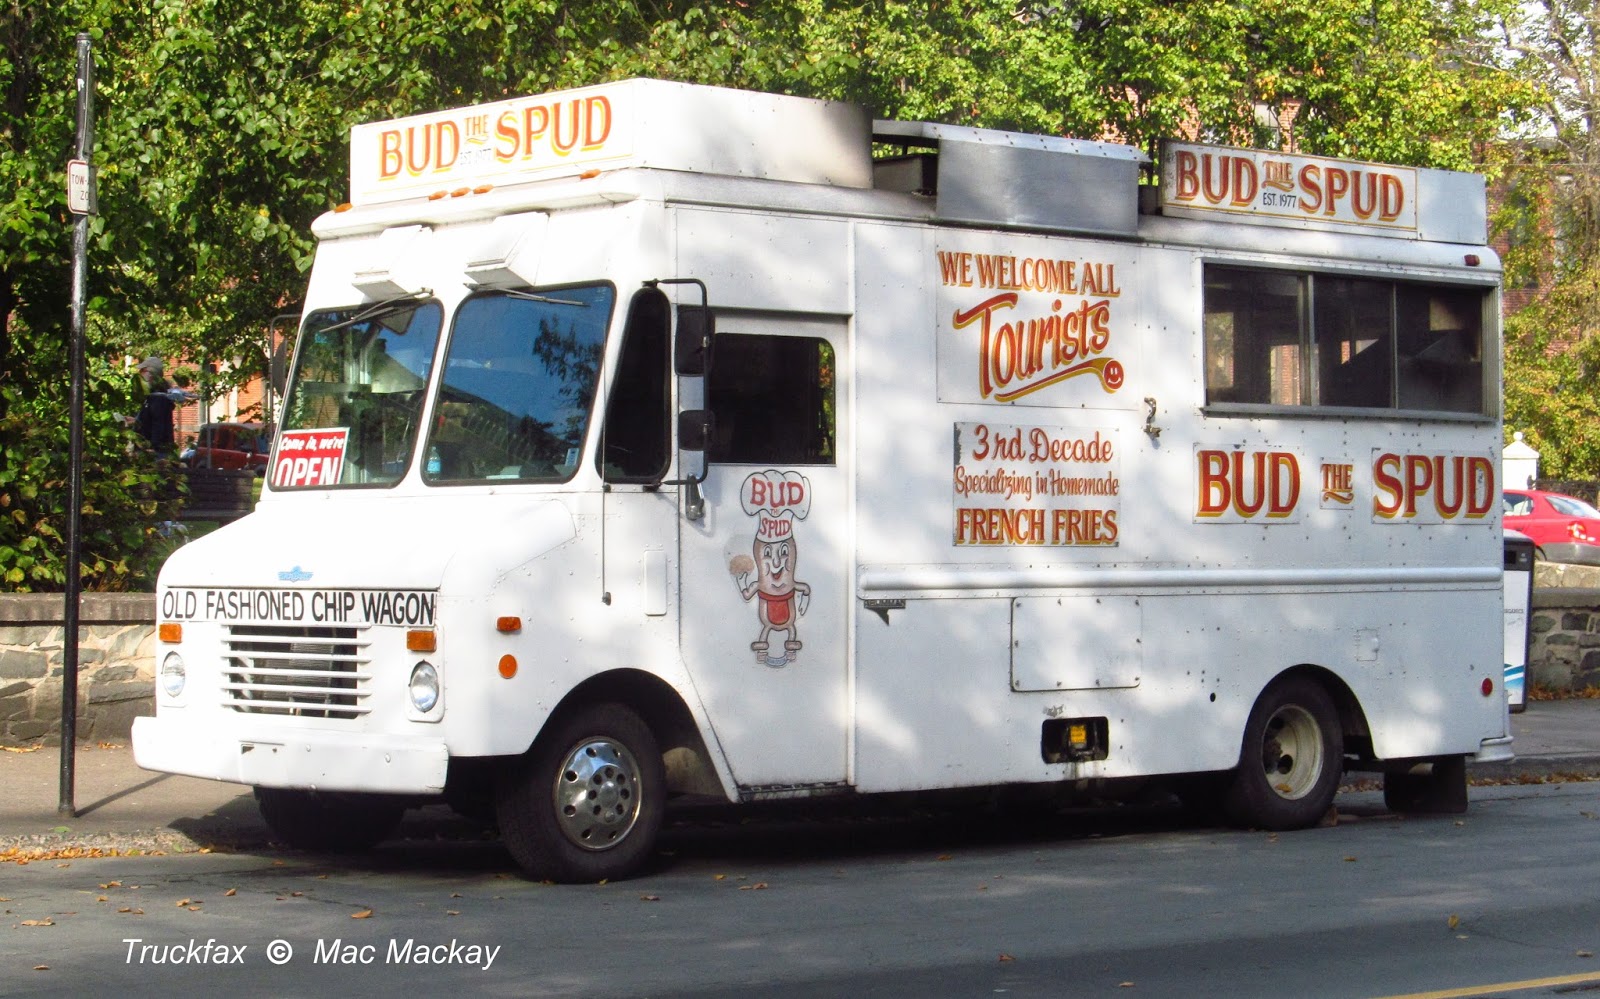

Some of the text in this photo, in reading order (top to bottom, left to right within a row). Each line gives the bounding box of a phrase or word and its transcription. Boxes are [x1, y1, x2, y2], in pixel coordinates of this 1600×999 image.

[378, 95, 612, 181] BUD THE SPUD
[1175, 150, 1405, 222] BUD THE SPUD
[1262, 192, 1297, 209] EST. 1977
[938, 251, 1121, 297] WE WELCOME ALL
[953, 292, 1111, 400] Tourists
[280, 436, 305, 451] Come
[319, 435, 345, 450] we're
[973, 424, 1114, 464] 3rd Decade
[274, 457, 340, 487] OPEN
[954, 465, 1119, 501] Specializing in Homemade
[1195, 450, 1495, 519] BUD THE SPUD
[751, 477, 804, 508] BUD
[760, 517, 791, 538] SPUD
[956, 508, 1118, 545] FRENCH FRIES
[162, 590, 436, 625] OLD FASHIONED CHIP WAGON
